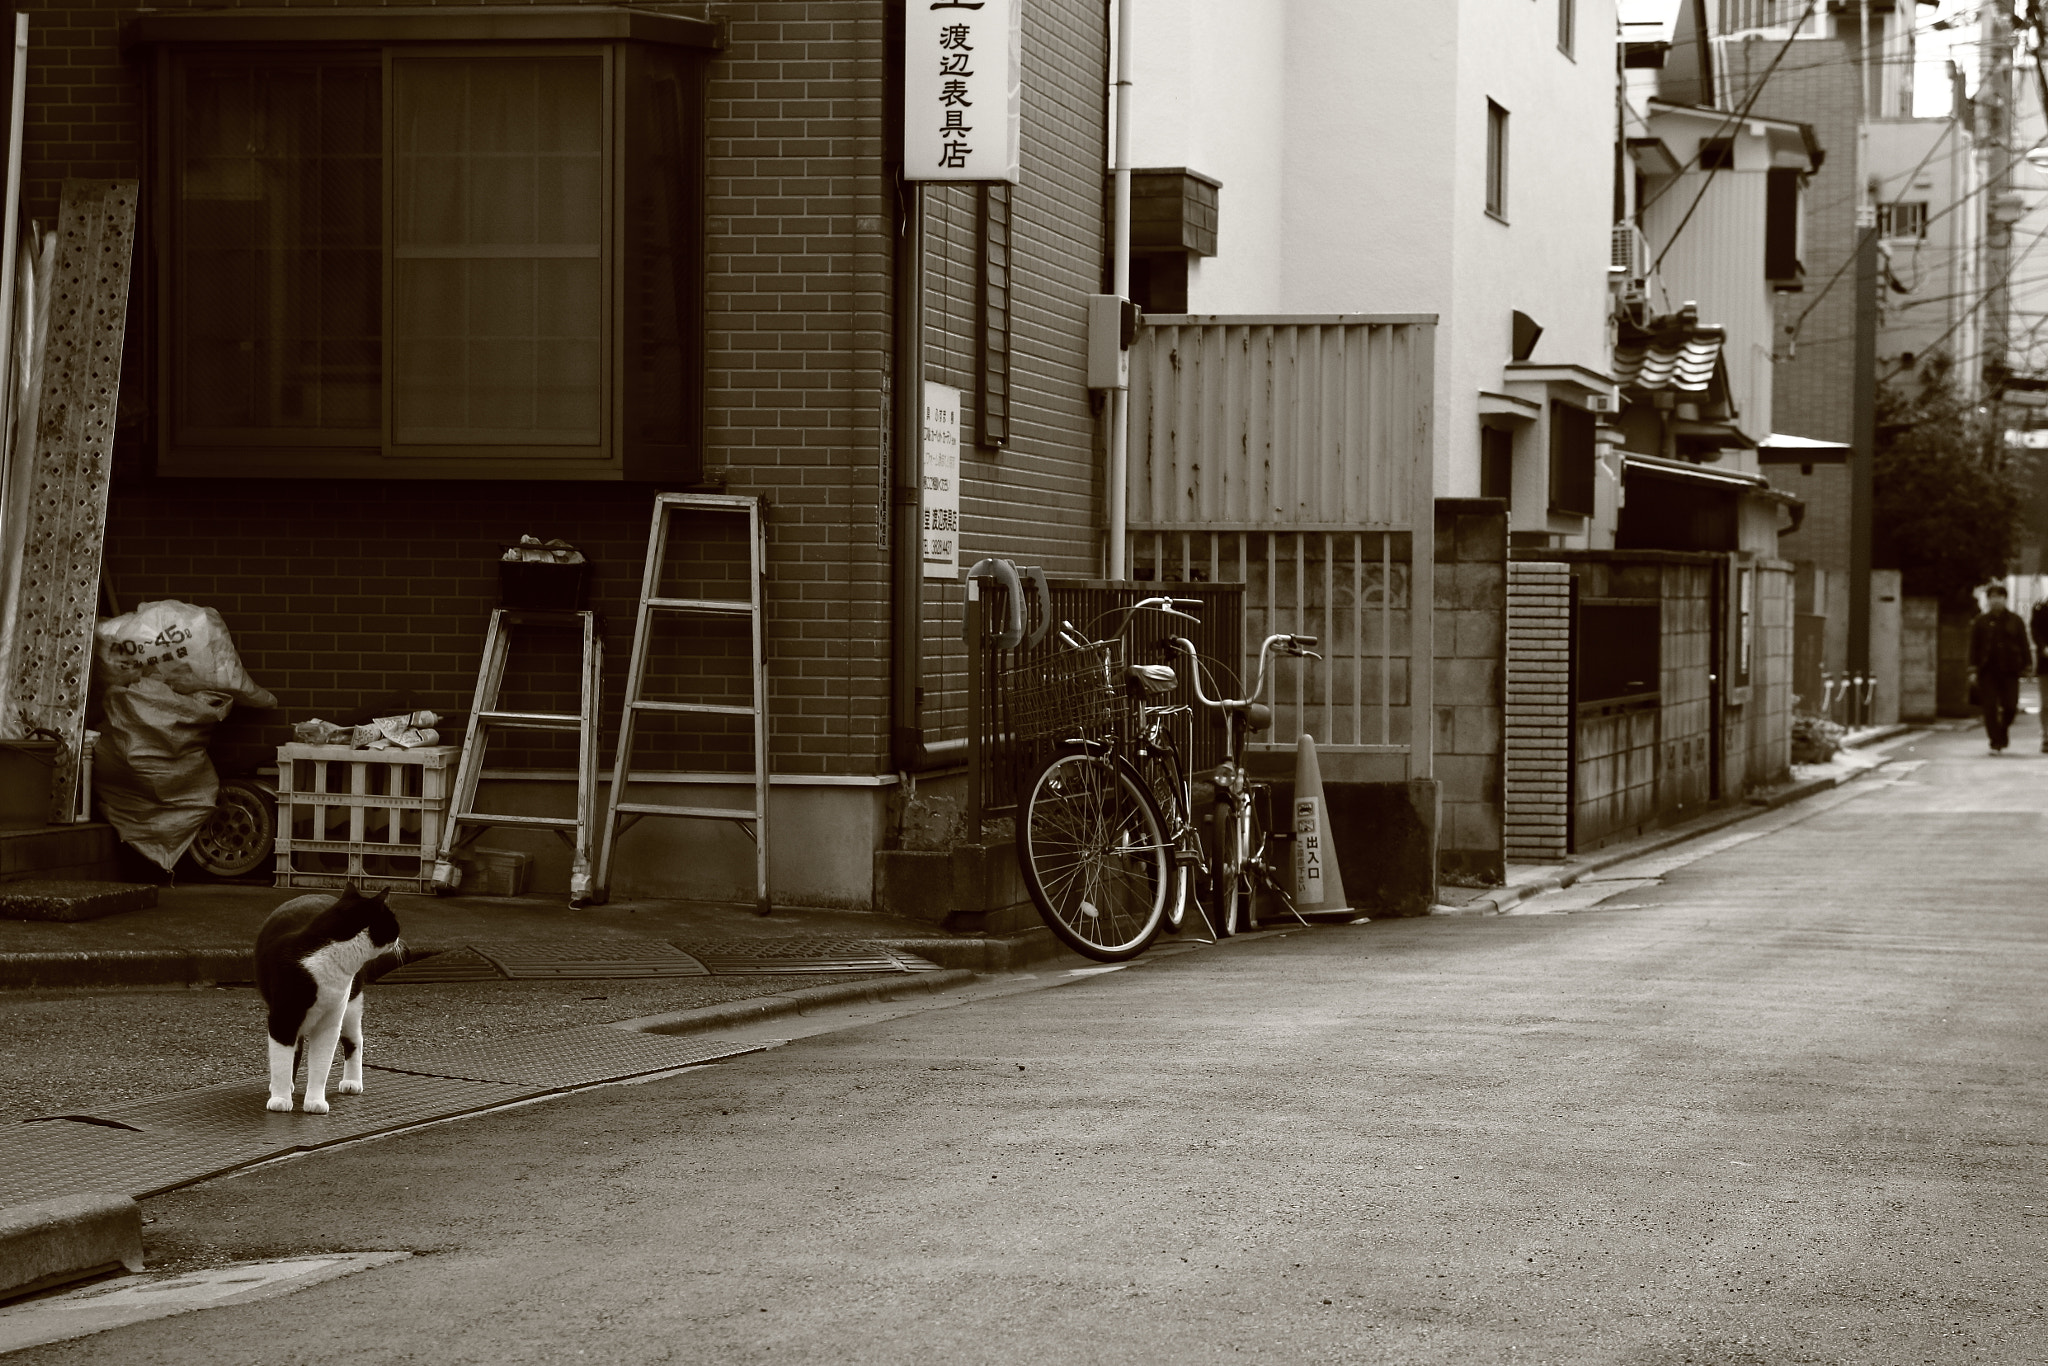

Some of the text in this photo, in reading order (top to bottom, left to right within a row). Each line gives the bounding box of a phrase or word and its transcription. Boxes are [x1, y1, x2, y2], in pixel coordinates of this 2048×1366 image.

[938, 22, 975, 169] 渡辺表具店
[1307, 836, 1320, 878] 出入口
